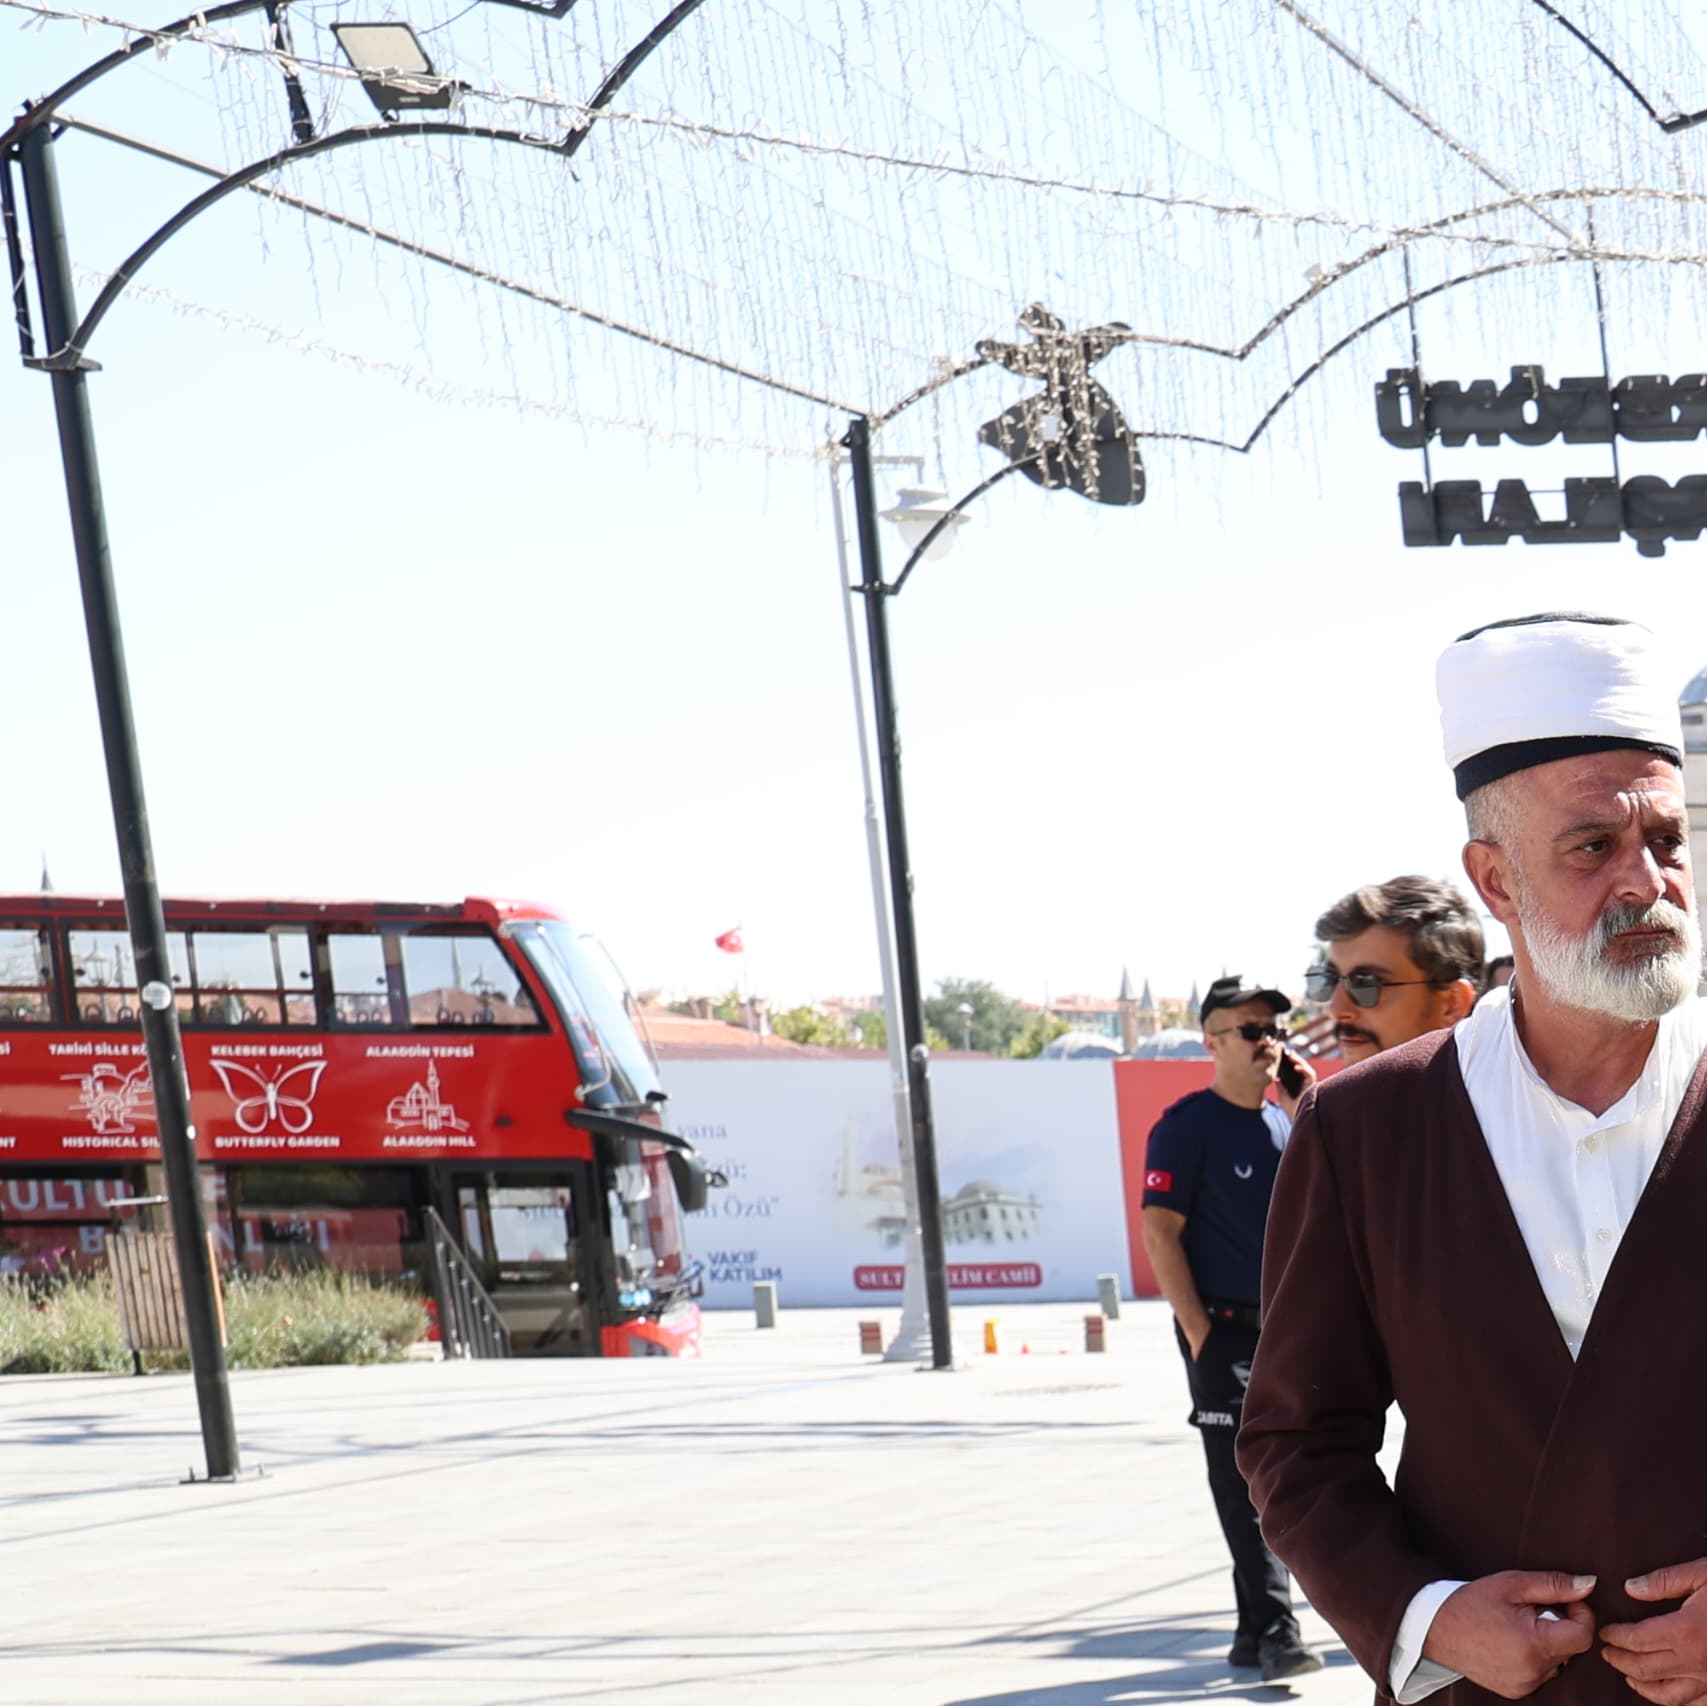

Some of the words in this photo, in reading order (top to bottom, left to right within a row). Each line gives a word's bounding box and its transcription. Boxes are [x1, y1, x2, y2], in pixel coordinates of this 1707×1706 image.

[48, 1041, 92, 1056] TARİHİ
[94, 1042, 130, 1056] SİLLE
[211, 1044, 267, 1057] KELEBEK
[269, 1043, 324, 1058] BAHÇESİ
[366, 1044, 429, 1057] ALAADDİN
[431, 1044, 475, 1058] TEPESİ
[62, 1136, 139, 1148] HISTORICAL
[215, 1136, 287, 1148] BUTTERFLY
[287, 1136, 340, 1148] GARDEN
[383, 1136, 446, 1148] ALAADDIN
[448, 1136, 476, 1148] HILL
[708, 1251, 758, 1265] VAKIF
[709, 1266, 783, 1282] KATILIM
